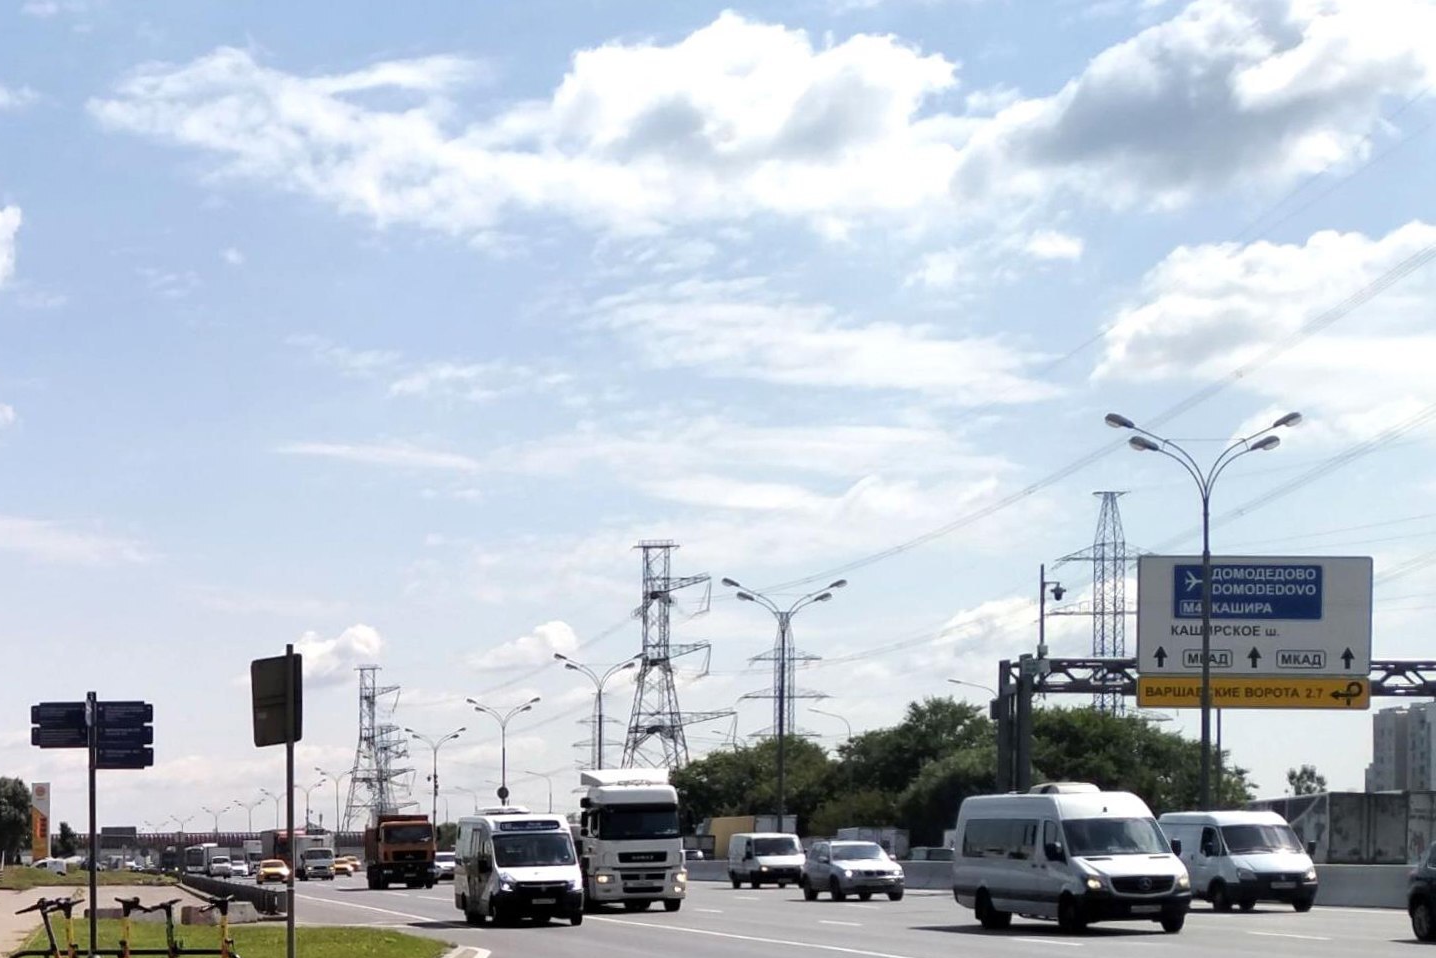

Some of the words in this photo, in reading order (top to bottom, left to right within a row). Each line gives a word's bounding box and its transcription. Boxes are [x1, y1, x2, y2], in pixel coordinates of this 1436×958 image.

[1211, 568, 1317, 581] ДОМОДЕДОВО
[1212, 584, 1317, 596] DOMODEDOVO
[1212, 602, 1273, 614] КАШИРА
[1171, 625, 1261, 637] КАШРСКОЕ
[1281, 654, 1322, 666] МКАД
[1245, 687, 1300, 698] ВОРОТА
